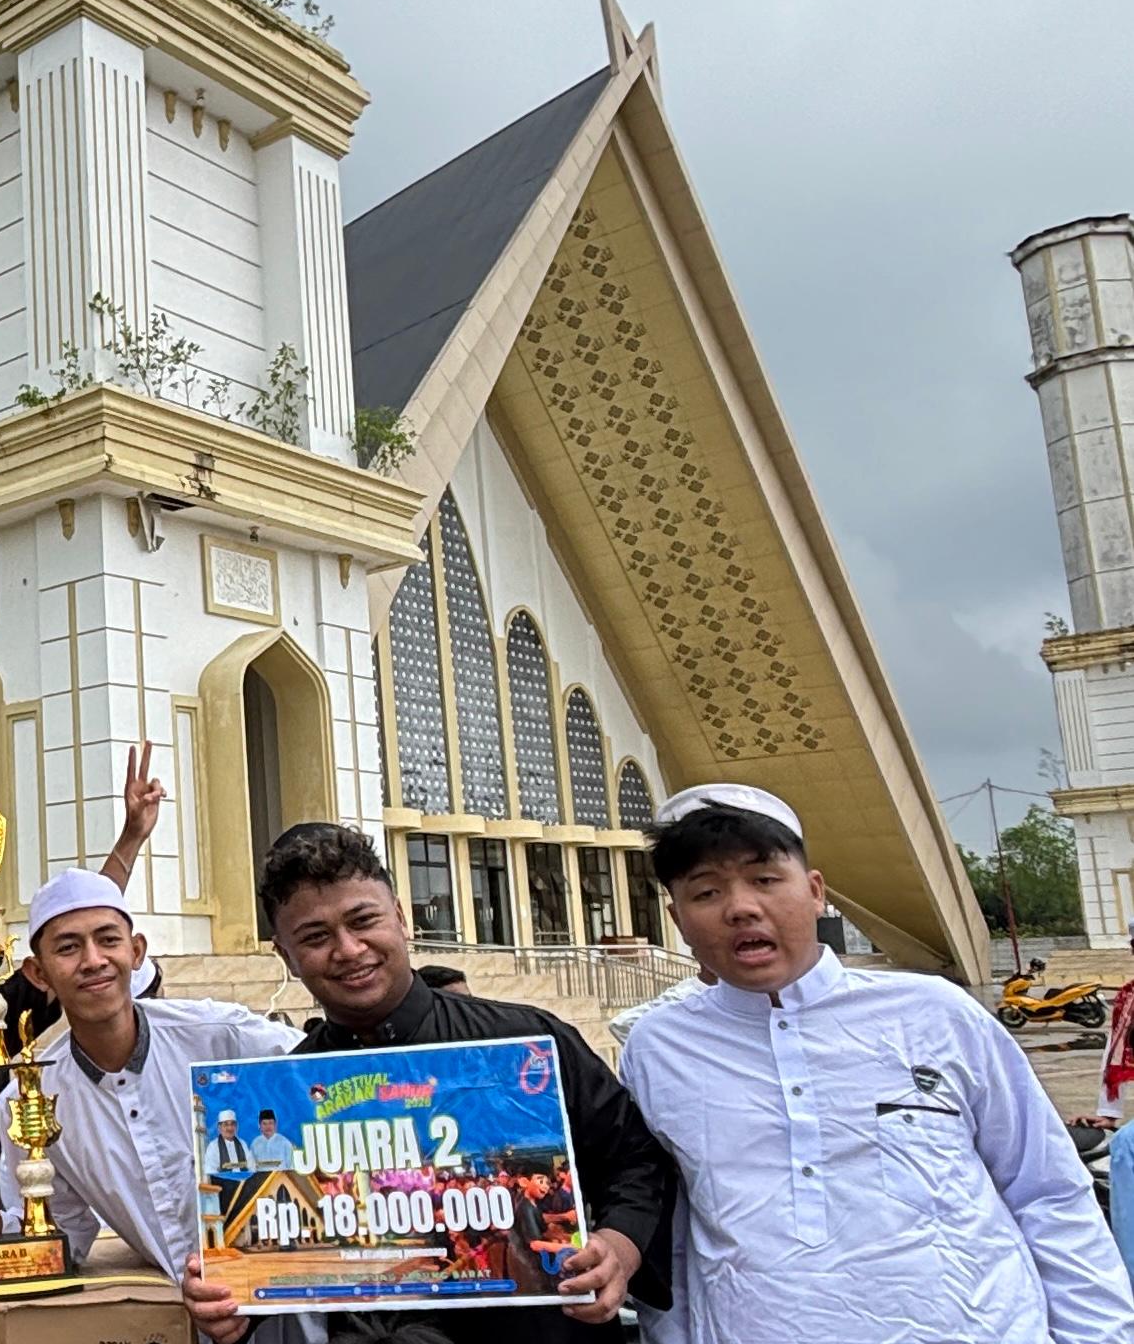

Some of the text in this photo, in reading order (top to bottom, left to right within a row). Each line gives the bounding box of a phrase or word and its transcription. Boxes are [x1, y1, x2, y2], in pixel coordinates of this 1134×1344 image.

[293, 1115, 463, 1175] JUARA 2
[256, 1185, 515, 1247] Rp. 18.000.000
[452, 1269, 492, 1280] BARAT
